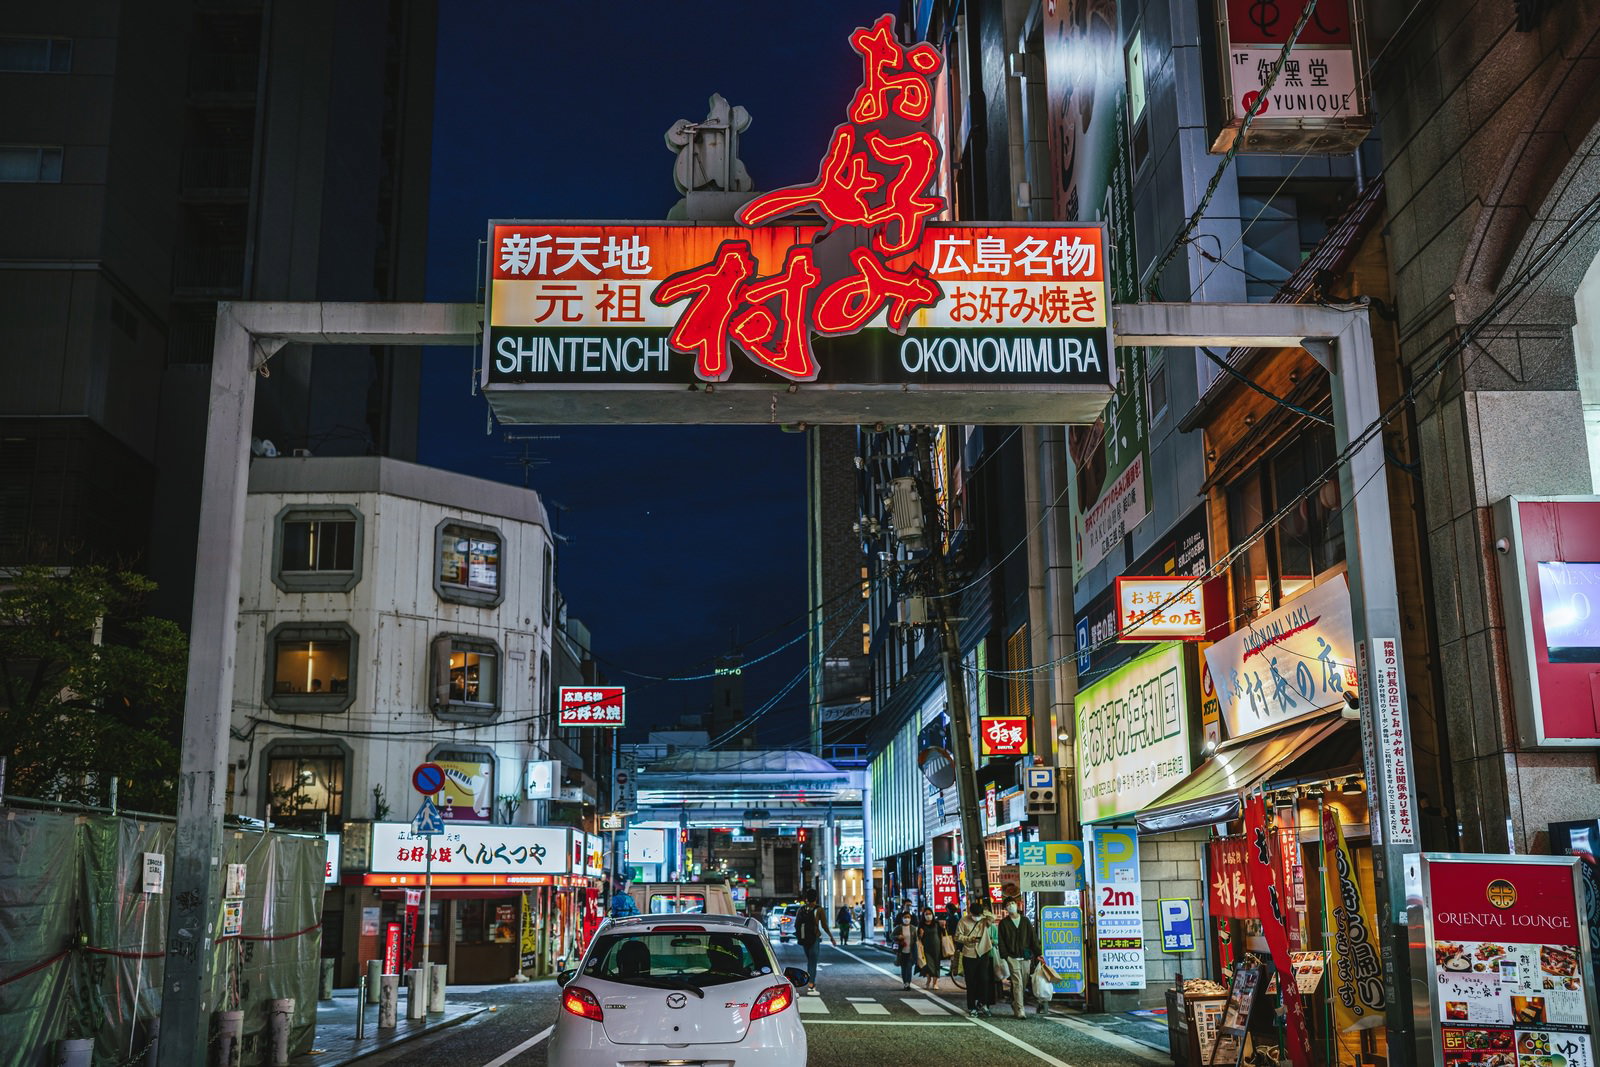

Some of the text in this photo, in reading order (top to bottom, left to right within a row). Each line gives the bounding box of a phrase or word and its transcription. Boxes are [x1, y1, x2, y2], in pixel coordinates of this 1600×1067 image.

[1232, 53, 1249, 65] 1F
[1273, 94, 1351, 111] YUNIQUE
[499, 234, 653, 277] 新天地
[929, 235, 1096, 278] 広島名物
[533, 284, 647, 324] 元祖
[948, 285, 1098, 326] お好み焼き
[495, 337, 670, 375] SHINTENCHI
[899, 337, 1102, 375] OKONOMIMURA
[986, 719, 1023, 746] すき家
[1031, 770, 1050, 787] P
[455, 842, 547, 866] へんくつや
[1022, 844, 1045, 865] 空
[1023, 870, 1072, 878] ワシントンホテル
[1102, 886, 1134, 906] 2m
[1162, 900, 1189, 932] P
[1437, 911, 1571, 929] ORIENTAL LOUNGE
[1165, 934, 1193, 948] 空車
[1107, 951, 1140, 962] PARCO
[1446, 1038, 1463, 1049] 5F
